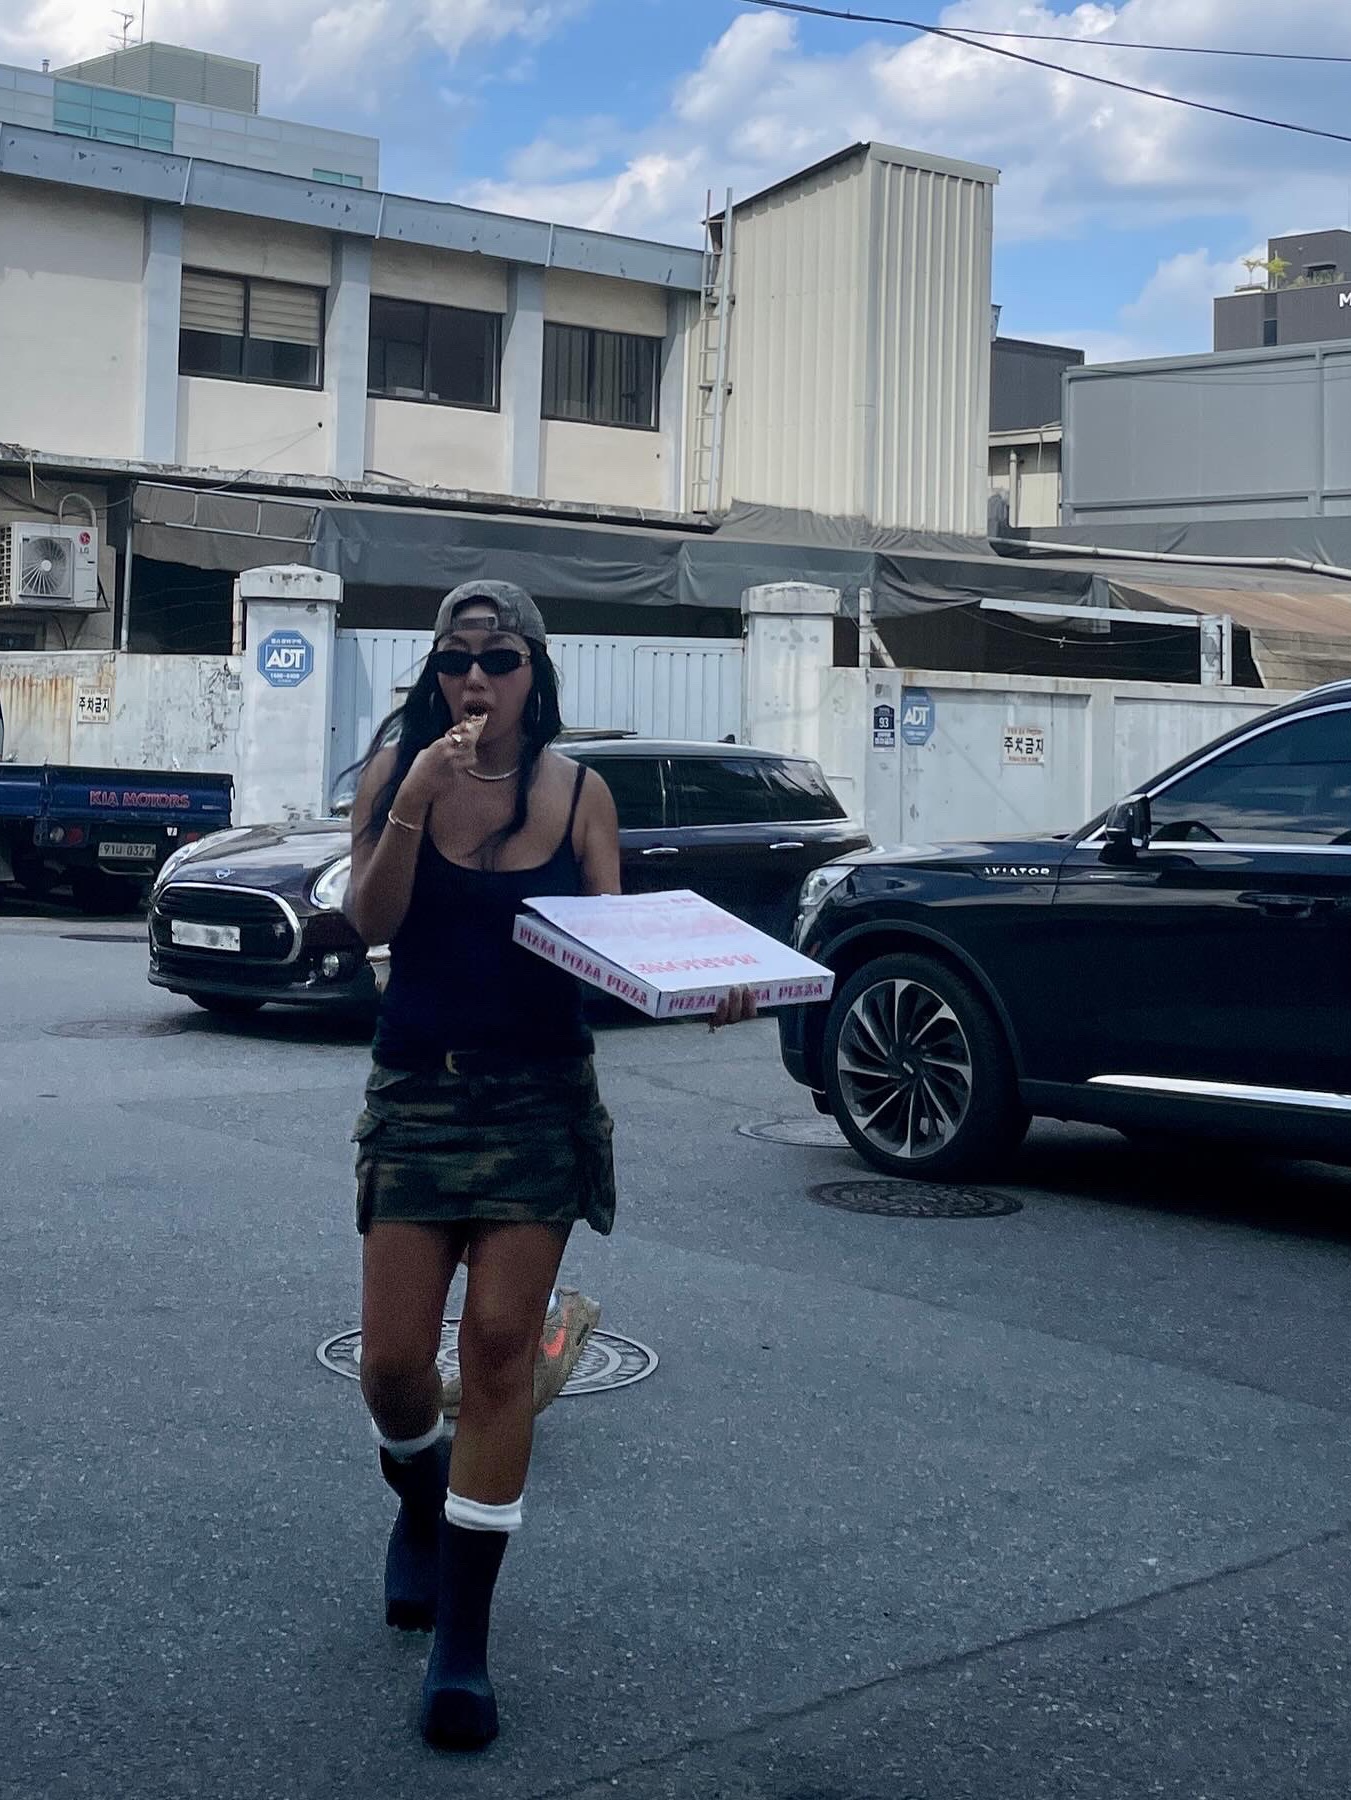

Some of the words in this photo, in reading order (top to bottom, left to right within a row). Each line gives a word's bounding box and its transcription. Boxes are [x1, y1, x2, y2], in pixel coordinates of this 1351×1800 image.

[266, 648, 306, 669] ADT
[79, 696, 110, 713] 주차금지
[878, 717, 889, 728] 93
[902, 706, 930, 726] ADT
[1003, 736, 1044, 755] 주차금지
[89, 790, 119, 807] KIA
[122, 791, 190, 809] MOTORS
[126, 845, 152, 857] 0327
[519, 926, 556, 958] PIZZA
[561, 948, 601, 982] PIZZA
[606, 972, 647, 1006] PIZZA
[778, 983, 823, 999] PIZZA
[668, 994, 716, 1013] PIZZA
